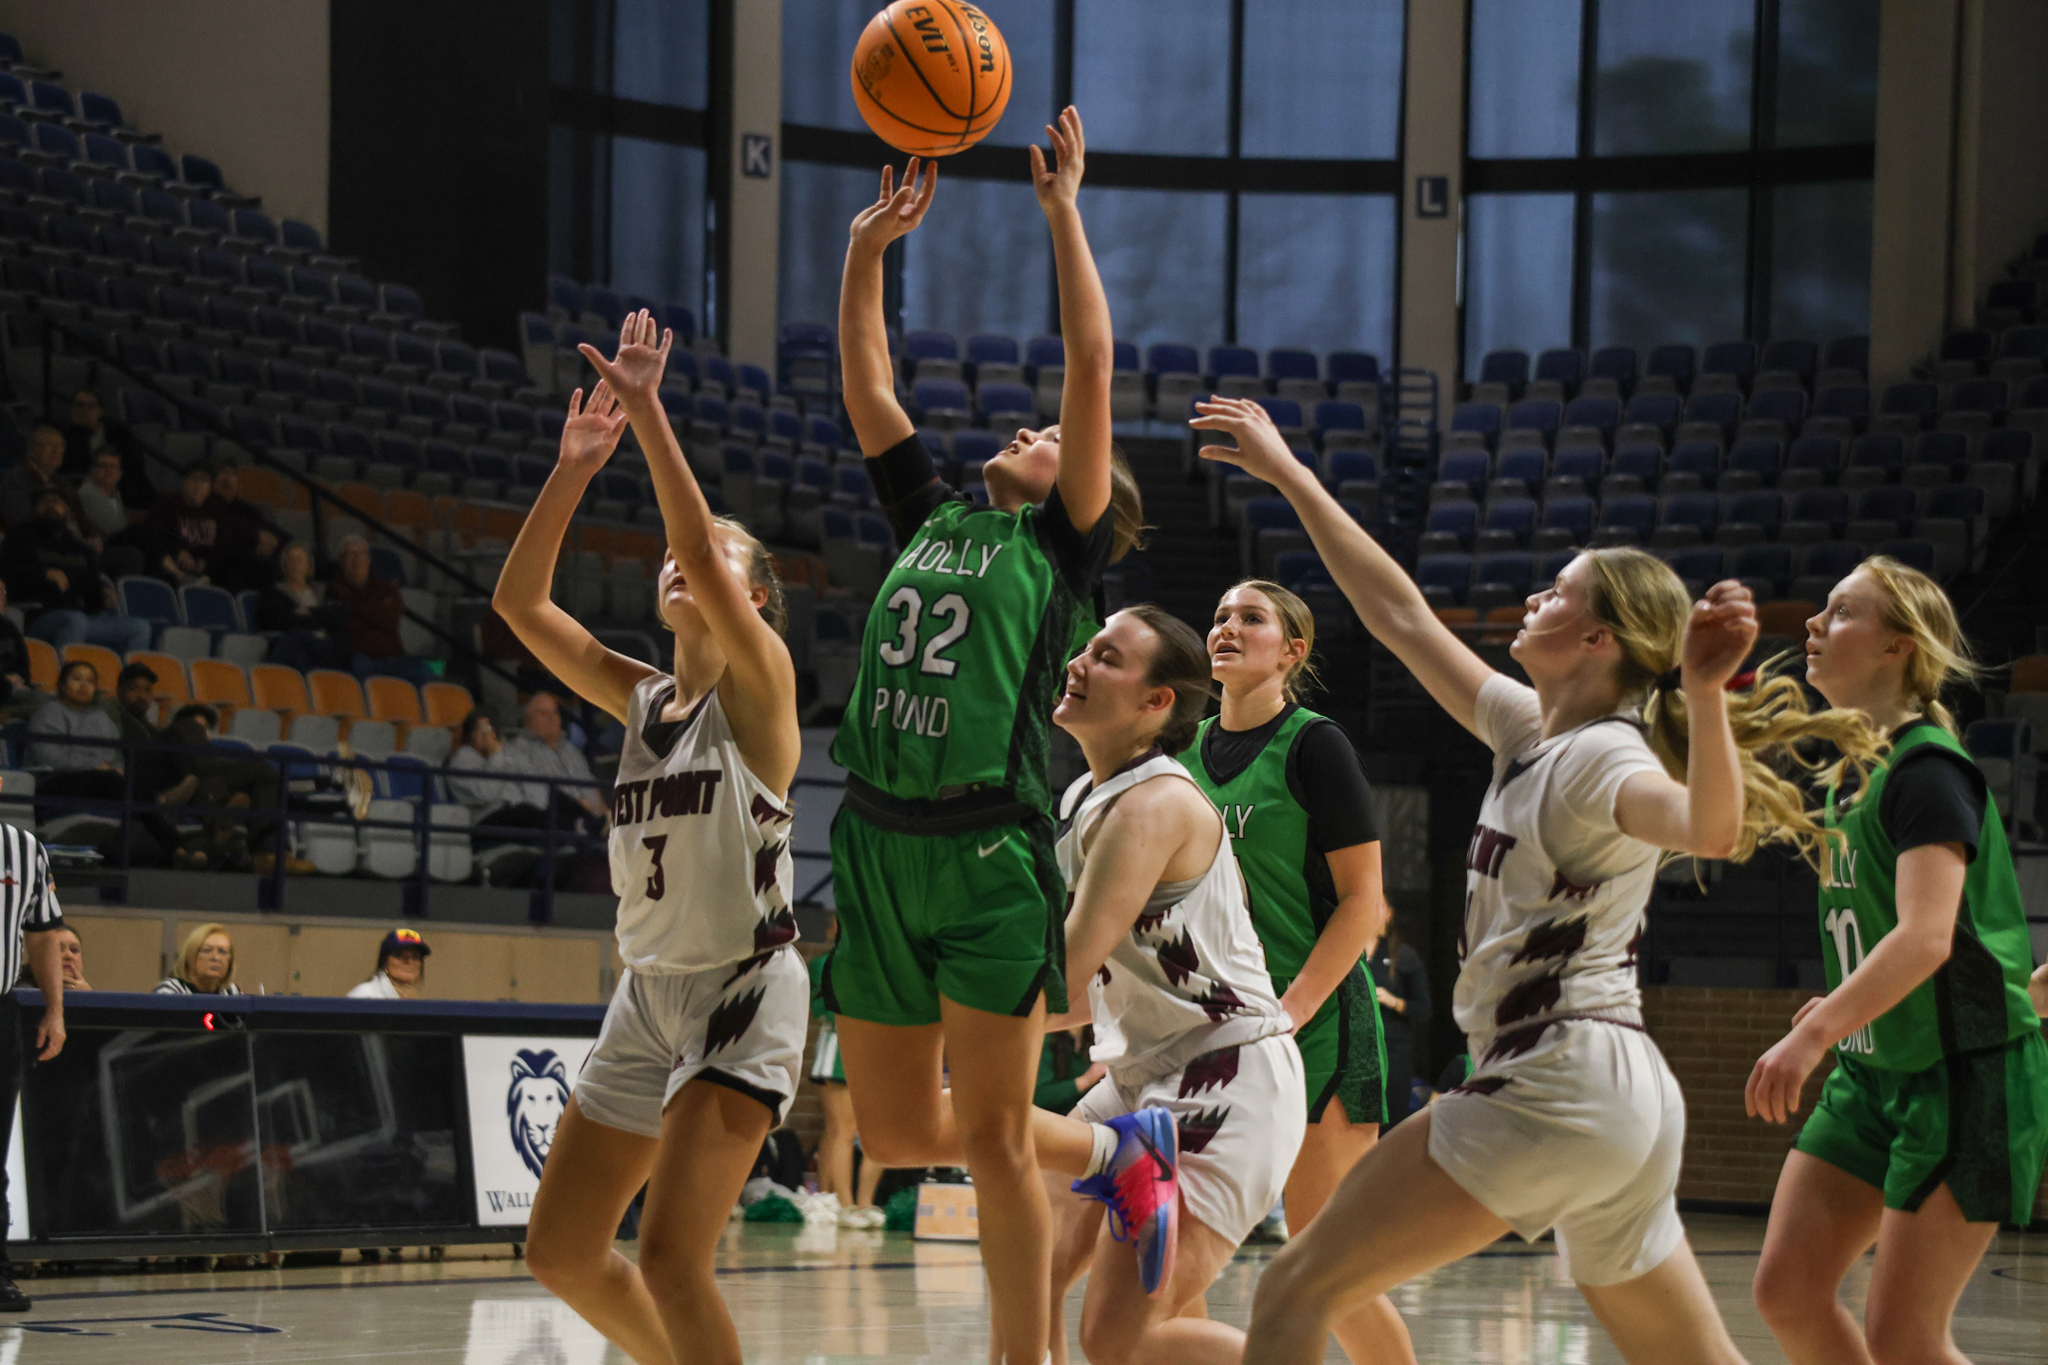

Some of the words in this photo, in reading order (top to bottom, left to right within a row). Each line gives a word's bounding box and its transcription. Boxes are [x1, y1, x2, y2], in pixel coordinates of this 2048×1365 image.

[905, 6, 950, 53] EVO
[746, 139, 768, 174] K
[1422, 180, 1443, 212] L
[879, 586, 971, 678] 32
[871, 687, 949, 738] POND
[647, 770, 723, 822] POINT
[641, 834, 669, 901] 3
[1824, 907, 1865, 984] 10
[485, 1190, 532, 1213] WALL
